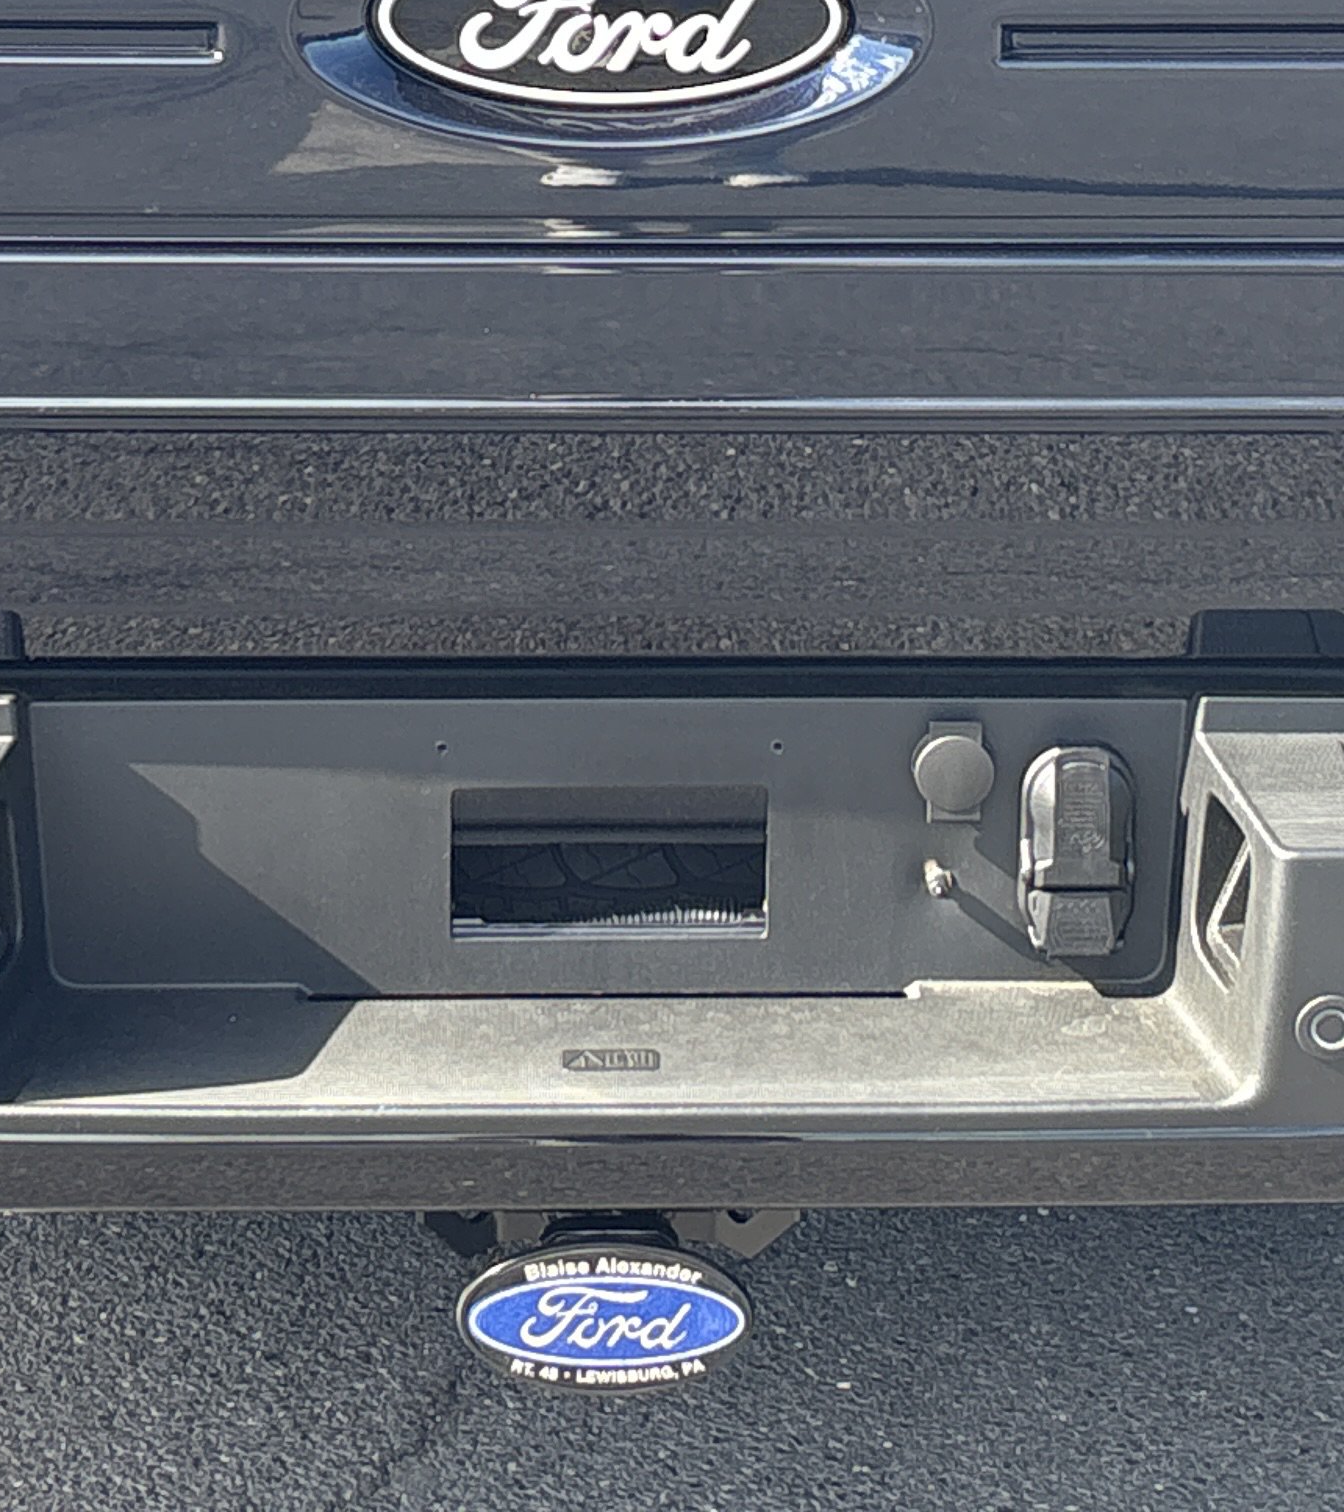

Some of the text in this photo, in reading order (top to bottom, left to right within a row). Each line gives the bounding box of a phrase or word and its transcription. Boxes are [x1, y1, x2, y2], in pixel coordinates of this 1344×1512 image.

[523, 1256, 703, 1285] Blaise Alexander
[519, 1286, 692, 1350] Ford
[575, 1363, 680, 1385] LEWISBURG,
[681, 1358, 706, 1377] PA
